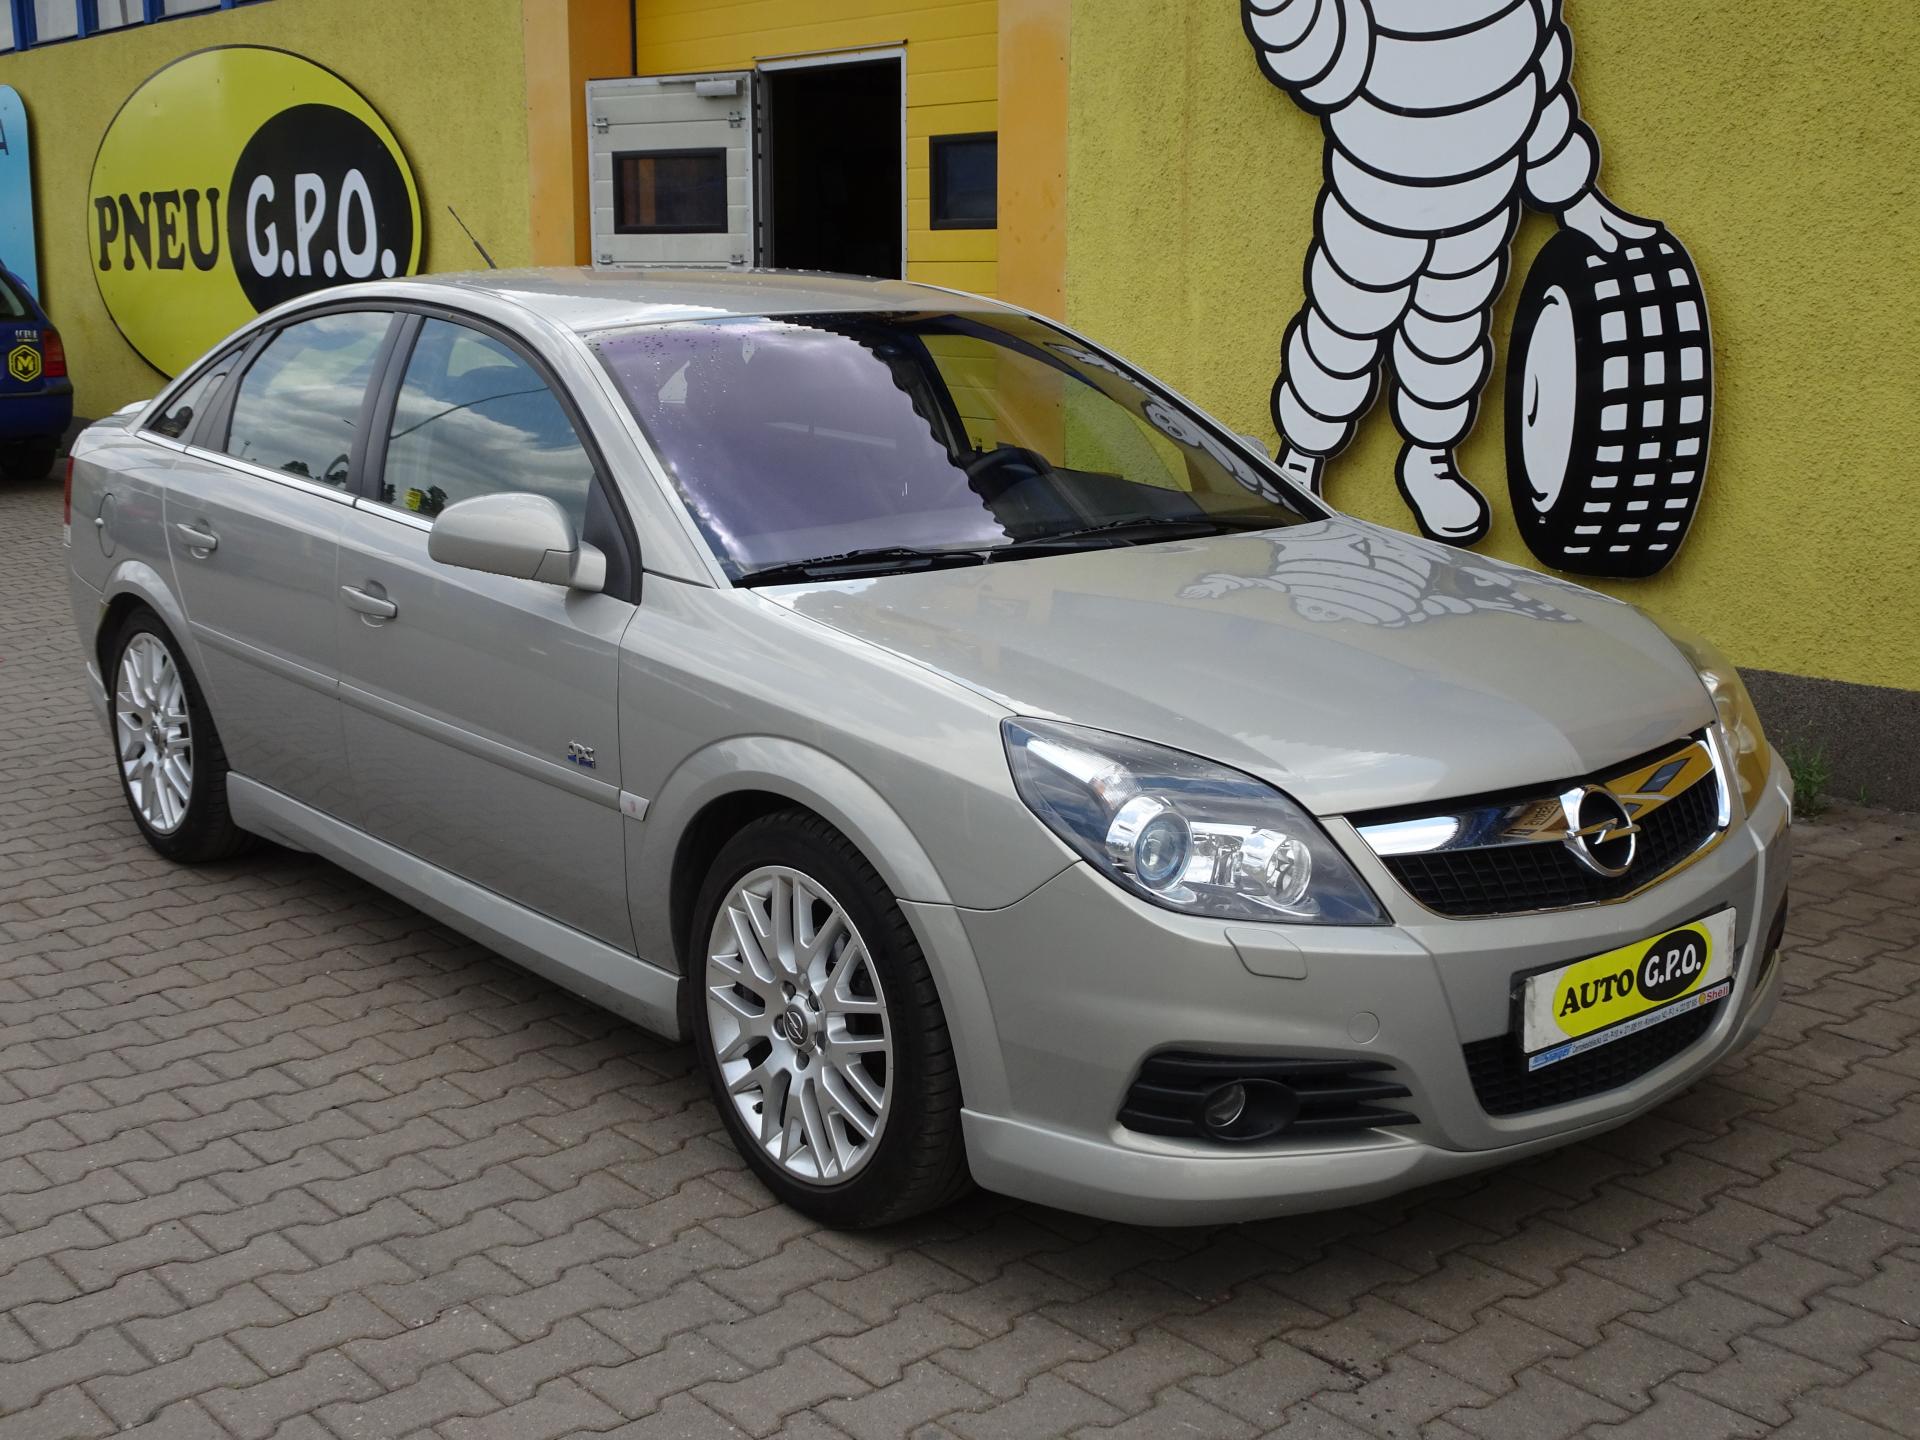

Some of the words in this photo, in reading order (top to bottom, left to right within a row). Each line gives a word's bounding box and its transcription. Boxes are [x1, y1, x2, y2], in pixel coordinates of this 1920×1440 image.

[95, 187, 220, 272] PNEU
[246, 168, 397, 279] G.P.O.
[17, 355, 34, 371] M
[1559, 969, 1634, 1017] AUTO
[1645, 944, 1701, 987] G.P.O.
[1706, 986, 1729, 1001] Shell
